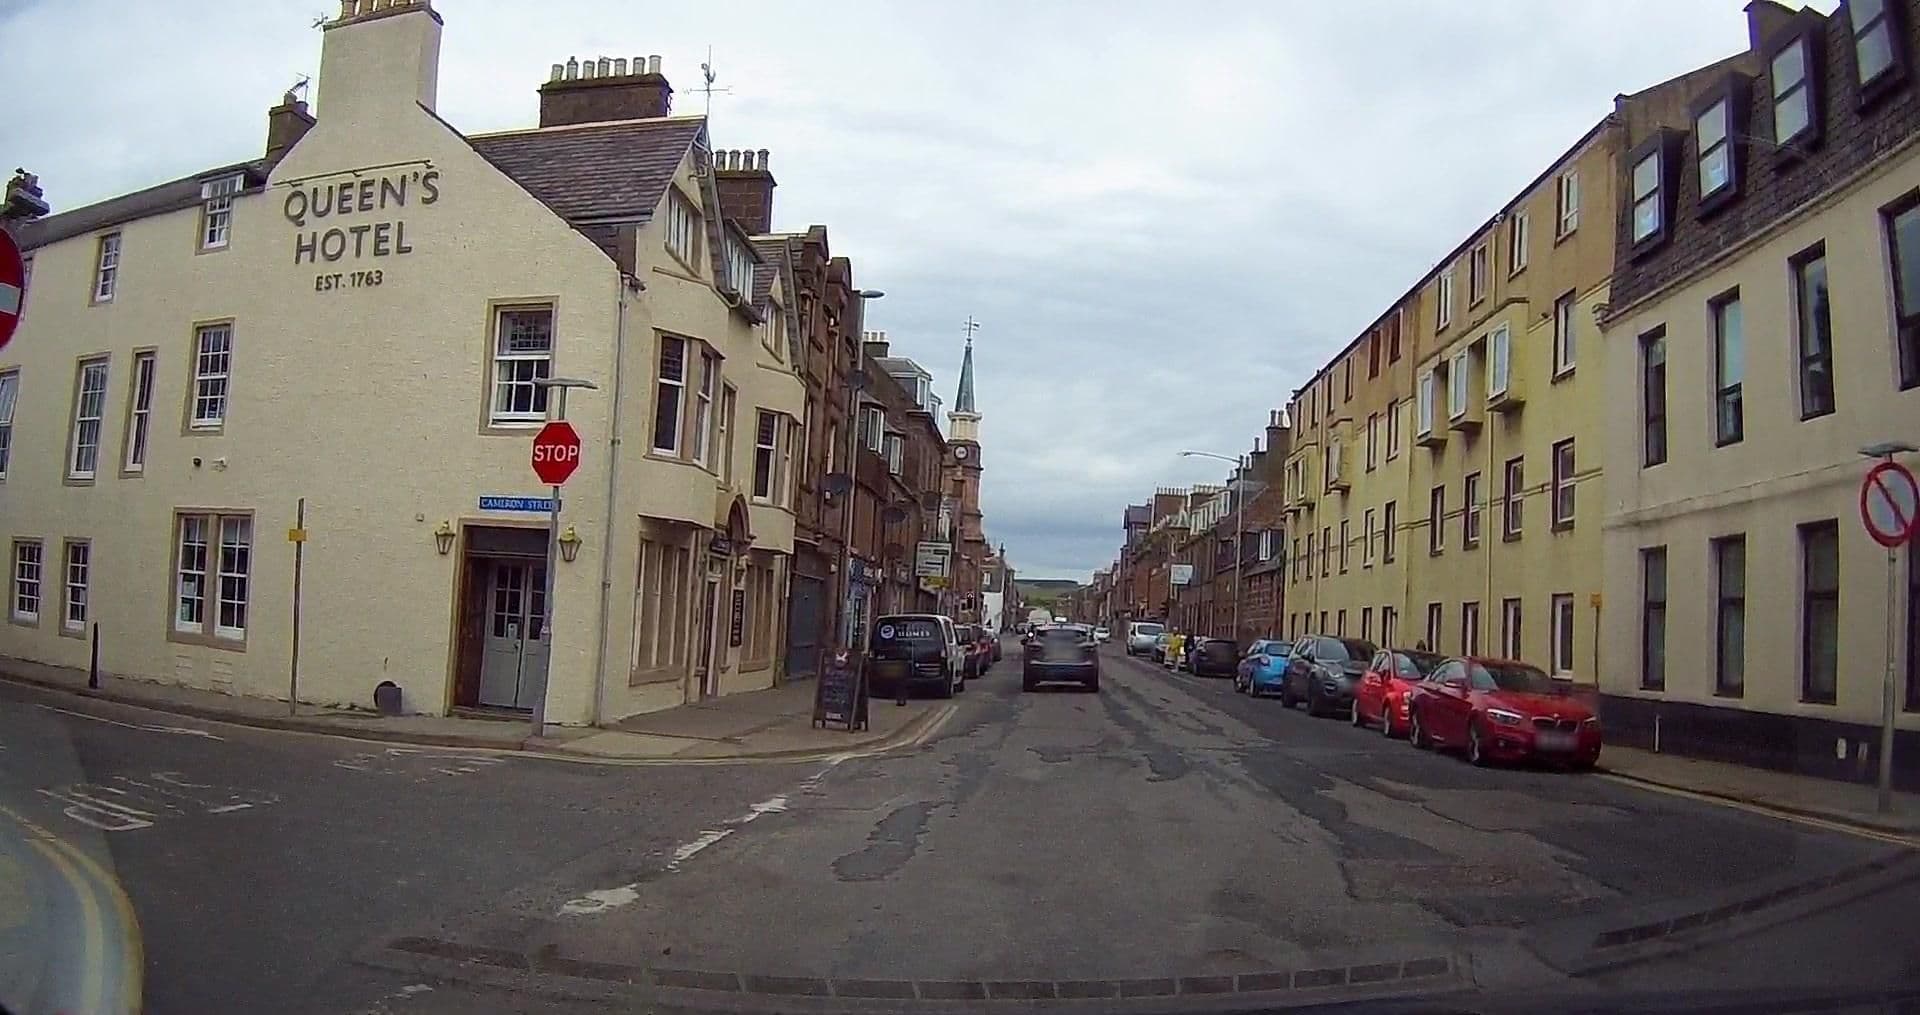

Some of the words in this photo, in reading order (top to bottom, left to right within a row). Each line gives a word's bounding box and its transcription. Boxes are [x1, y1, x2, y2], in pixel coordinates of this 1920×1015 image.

[284, 171, 440, 227] QUEEN'S
[294, 221, 413, 265] HOTEL
[315, 273, 346, 291] EST.
[350, 270, 384, 288] 1763
[533, 444, 578, 462] STOP
[481, 498, 524, 509] CAMERON
